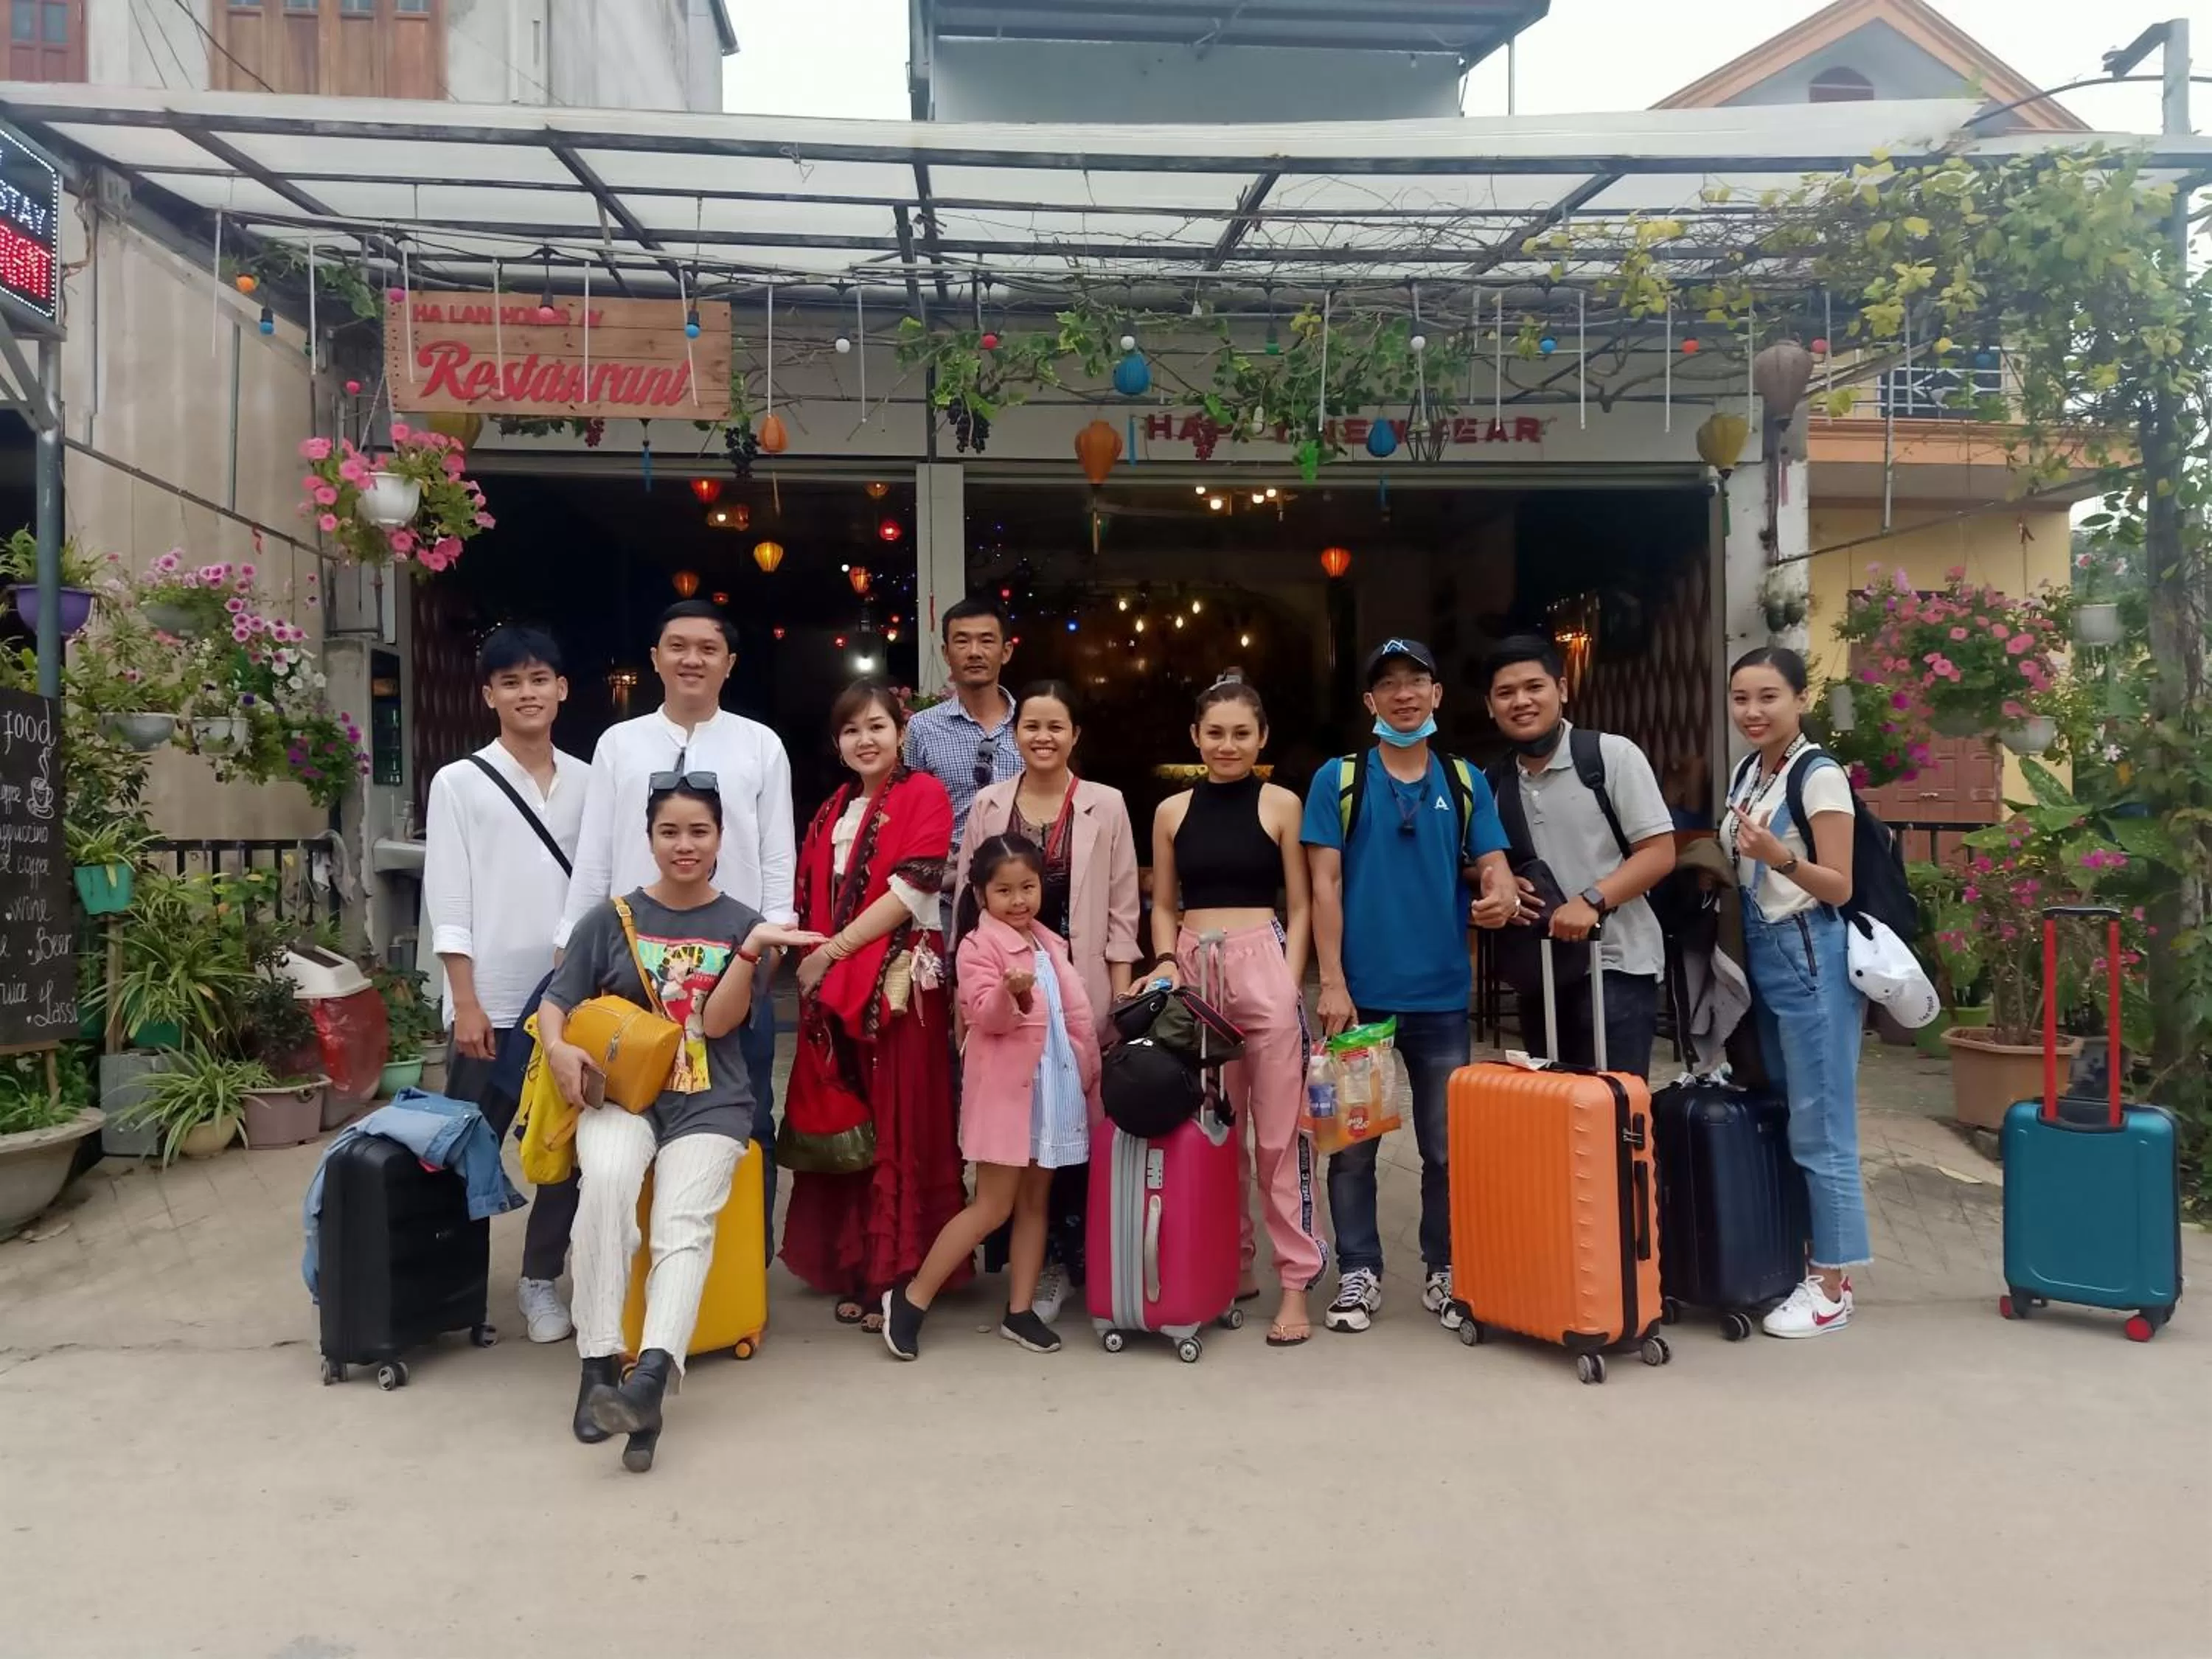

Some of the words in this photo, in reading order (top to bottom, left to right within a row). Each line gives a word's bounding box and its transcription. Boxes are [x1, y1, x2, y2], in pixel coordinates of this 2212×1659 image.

[412, 303, 441, 322] HA
[449, 305, 492, 324] LAN
[417, 340, 694, 406] Restaurant
[29, 927, 72, 966] Beer
[34, 979, 78, 1027] Lassi
